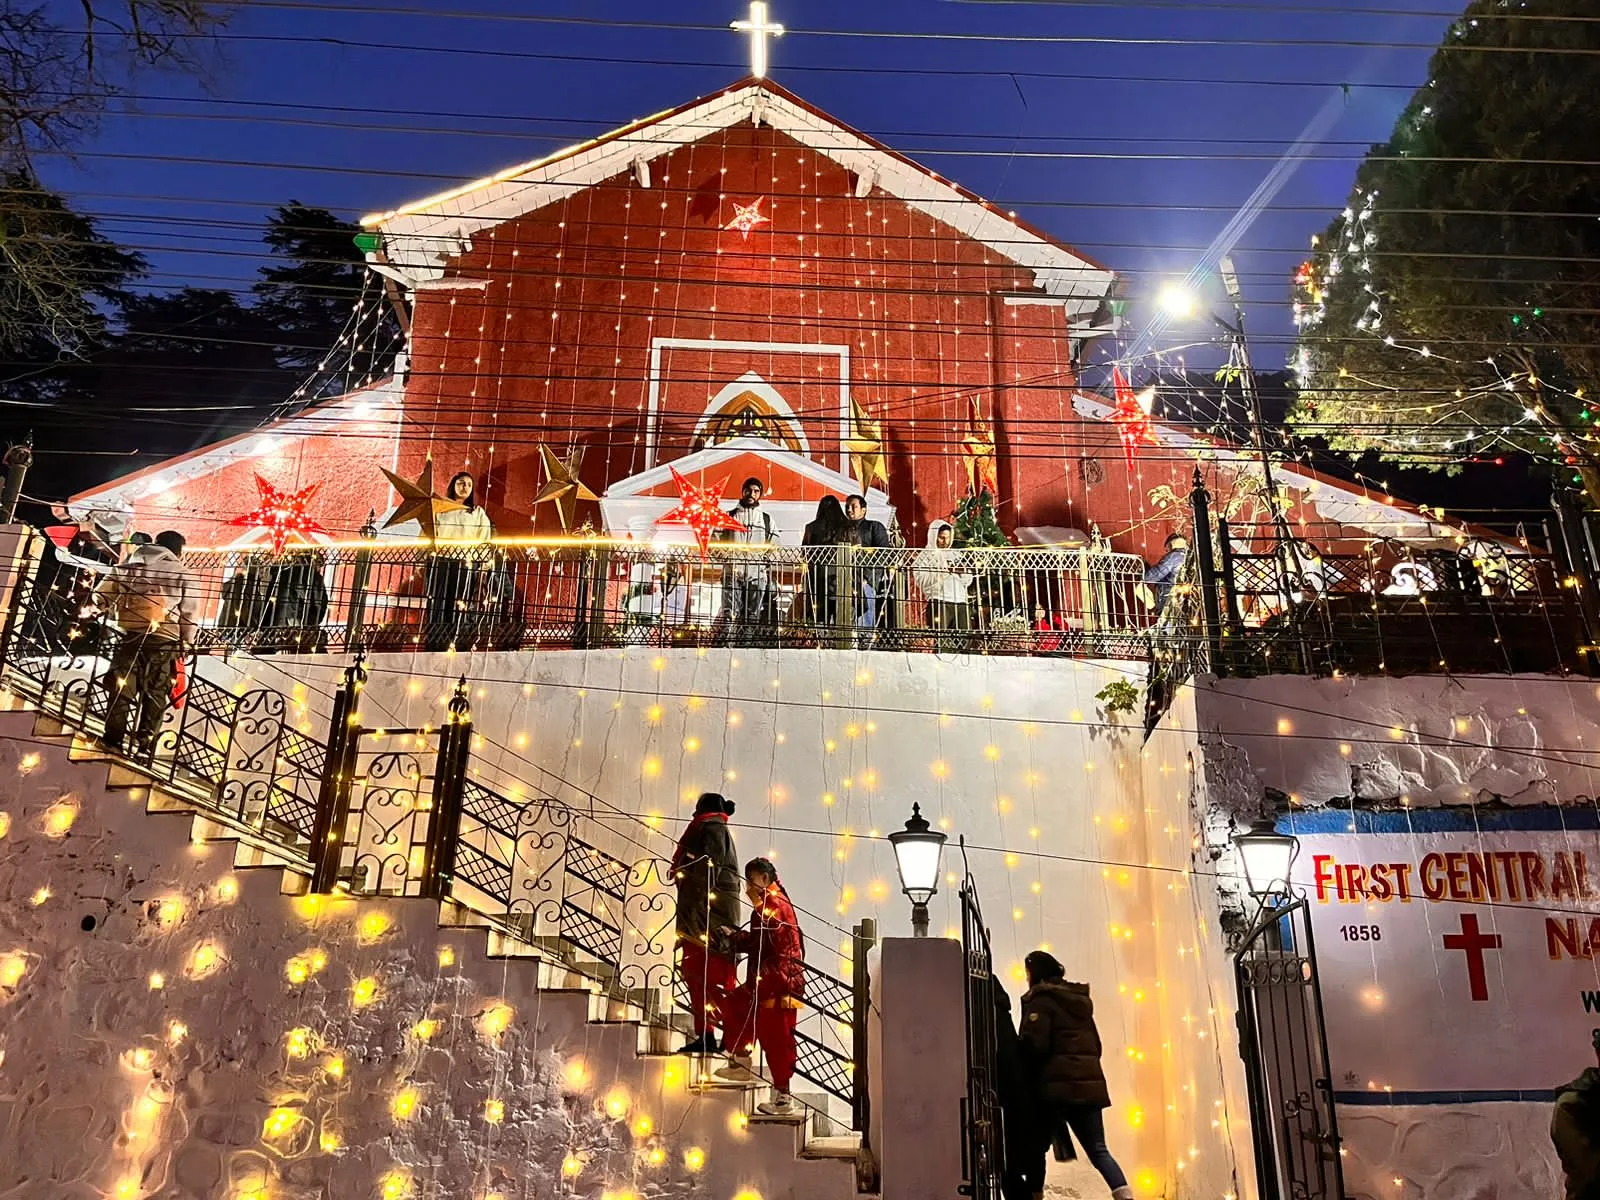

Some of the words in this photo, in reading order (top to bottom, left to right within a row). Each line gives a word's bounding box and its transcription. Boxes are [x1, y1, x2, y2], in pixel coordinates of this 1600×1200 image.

[1312, 854, 1412, 903] FIRST
[1419, 851, 1598, 902] CENTRAL
[1339, 924, 1381, 941] 1858
